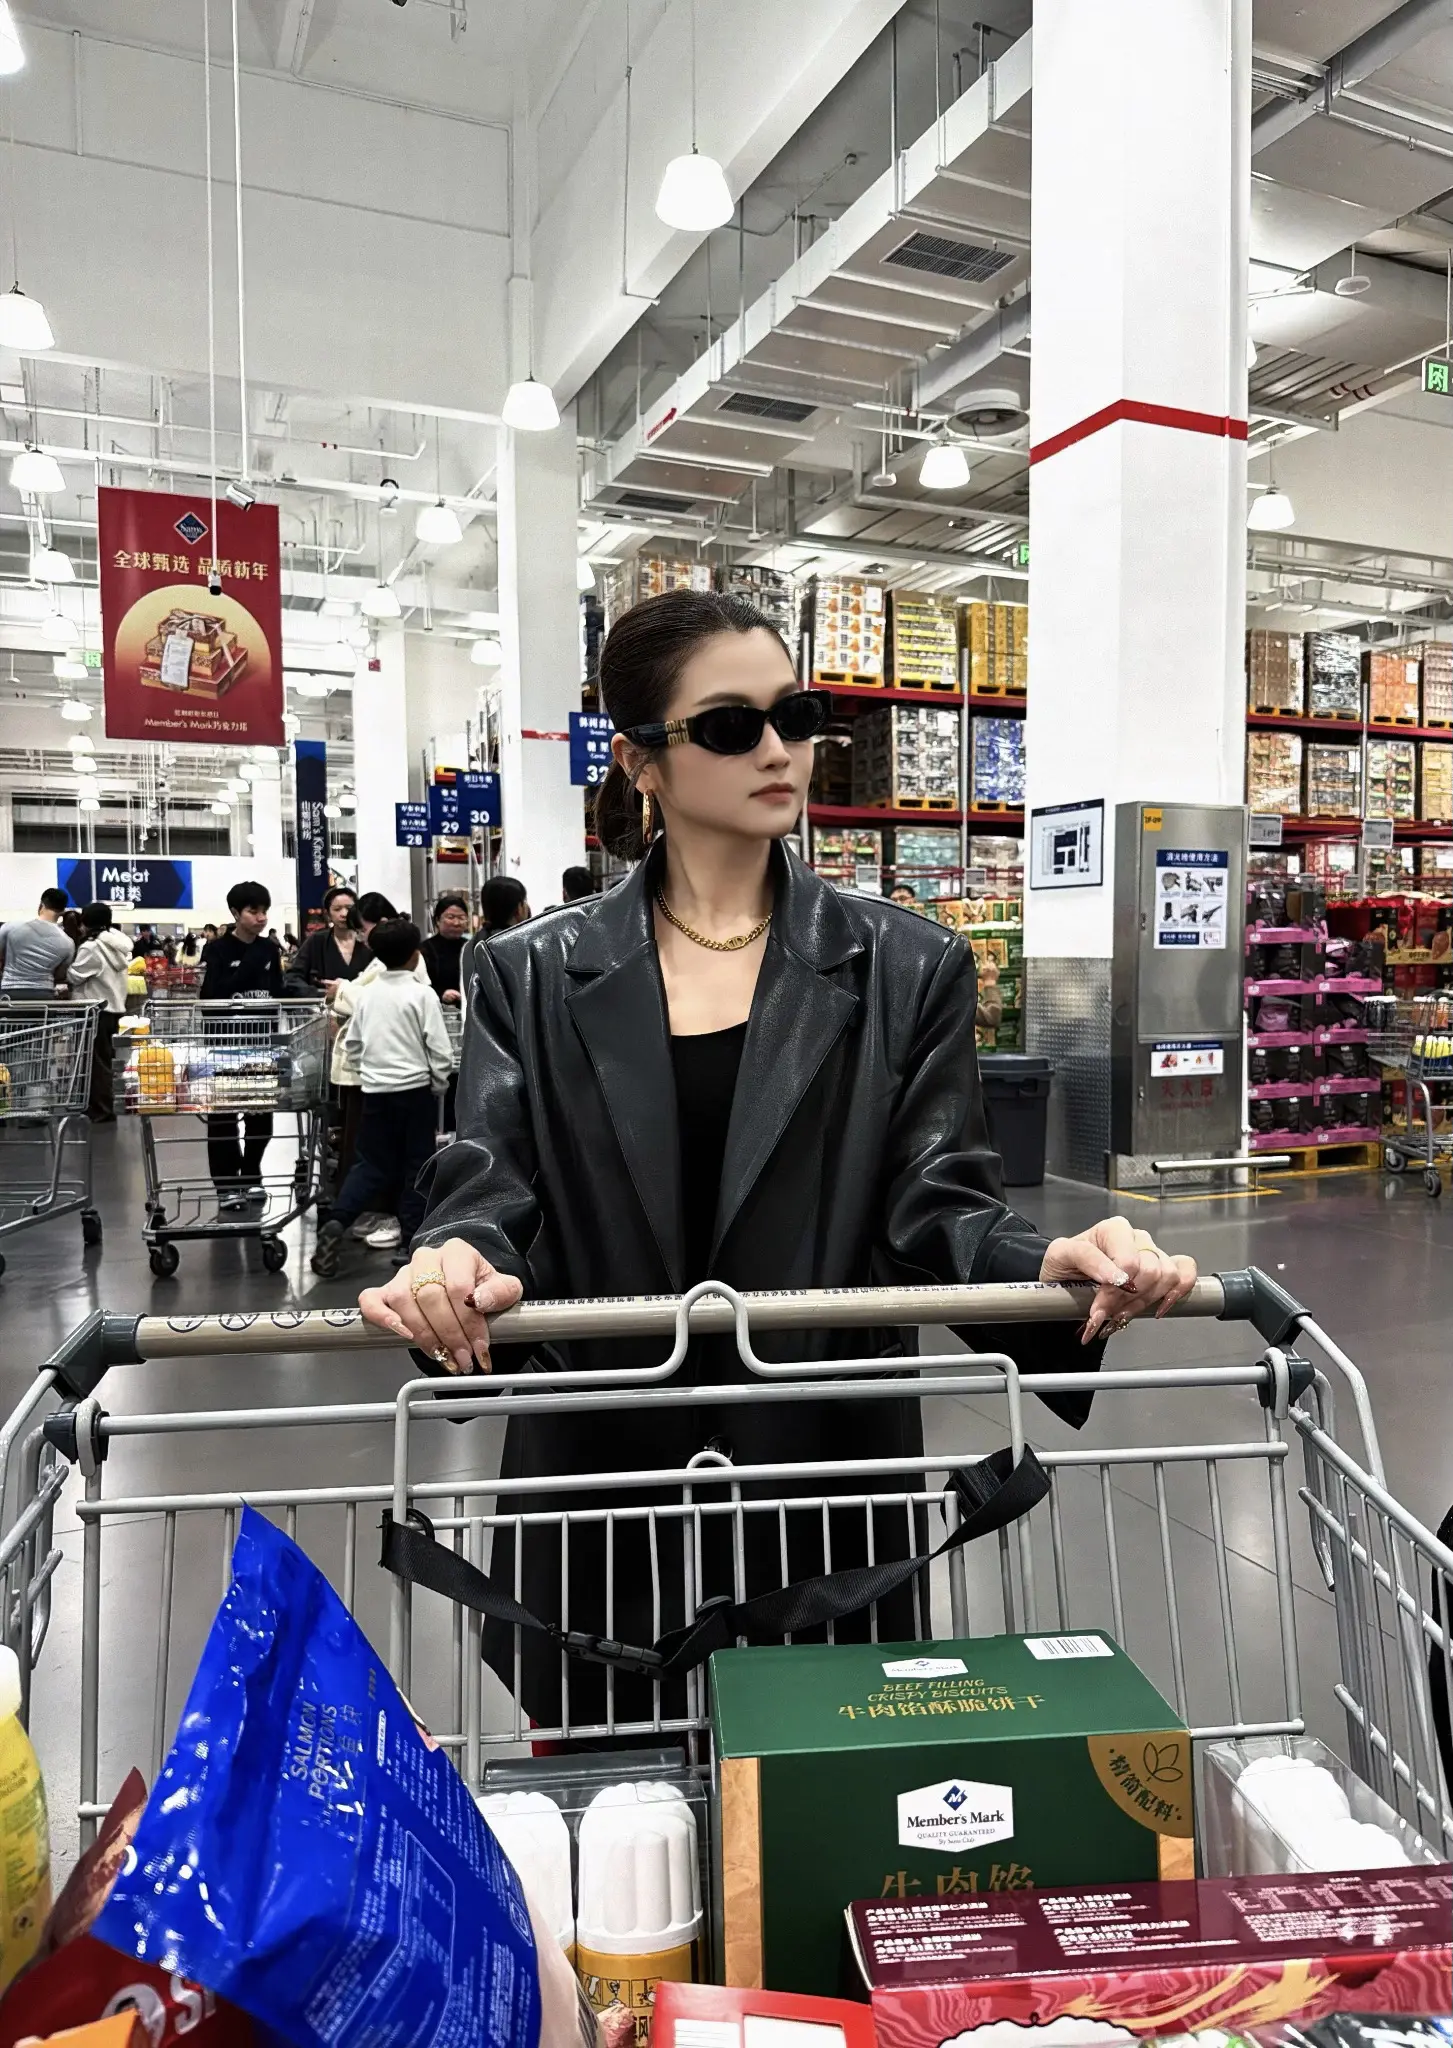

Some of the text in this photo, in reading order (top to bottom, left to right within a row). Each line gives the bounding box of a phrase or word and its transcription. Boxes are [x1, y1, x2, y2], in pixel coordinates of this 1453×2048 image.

[113, 550, 190, 574] 全球甄选
[470, 810, 490, 824] 30
[441, 821, 460, 834] 29
[312, 802, 325, 877] Sam's Kitchen
[406, 834, 423, 845] 28
[102, 866, 150, 883] Meat
[110, 885, 142, 902] 肉类
[867, 1686, 1008, 1702] CRISPY BISCUITS
[882, 1679, 985, 1692] BEEF FILLING
[838, 1695, 1046, 1720] 牛肉馅酥脆饼干
[290, 1700, 317, 1781] SALMON
[308, 1703, 338, 1800] PORTIONS
[1109, 1754, 1174, 1822] 精简配料
[907, 1810, 1005, 1828] Member's Mark
[917, 1828, 995, 1839] QUALITY GUARANTEED
